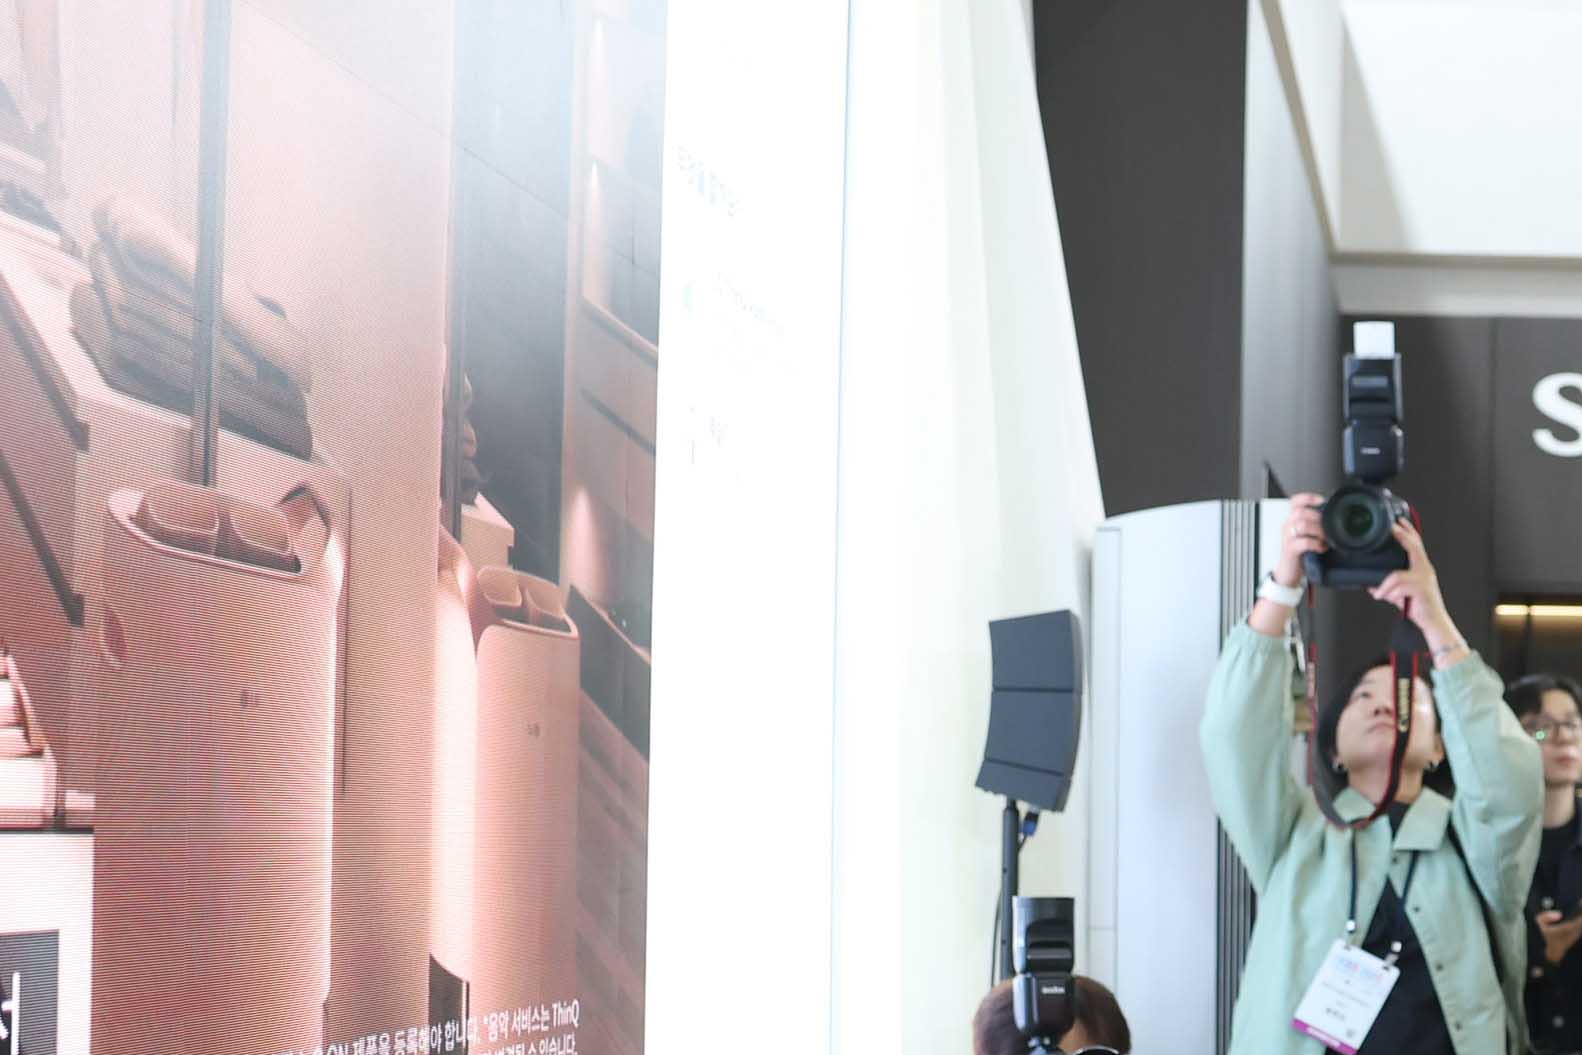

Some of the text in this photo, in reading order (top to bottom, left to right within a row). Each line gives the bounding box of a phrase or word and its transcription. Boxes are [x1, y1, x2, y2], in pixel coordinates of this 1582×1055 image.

[444, 1017, 480, 1052] 합니다.
[511, 1004, 550, 1037] 서비스는
[552, 998, 580, 1028] ThinQ
